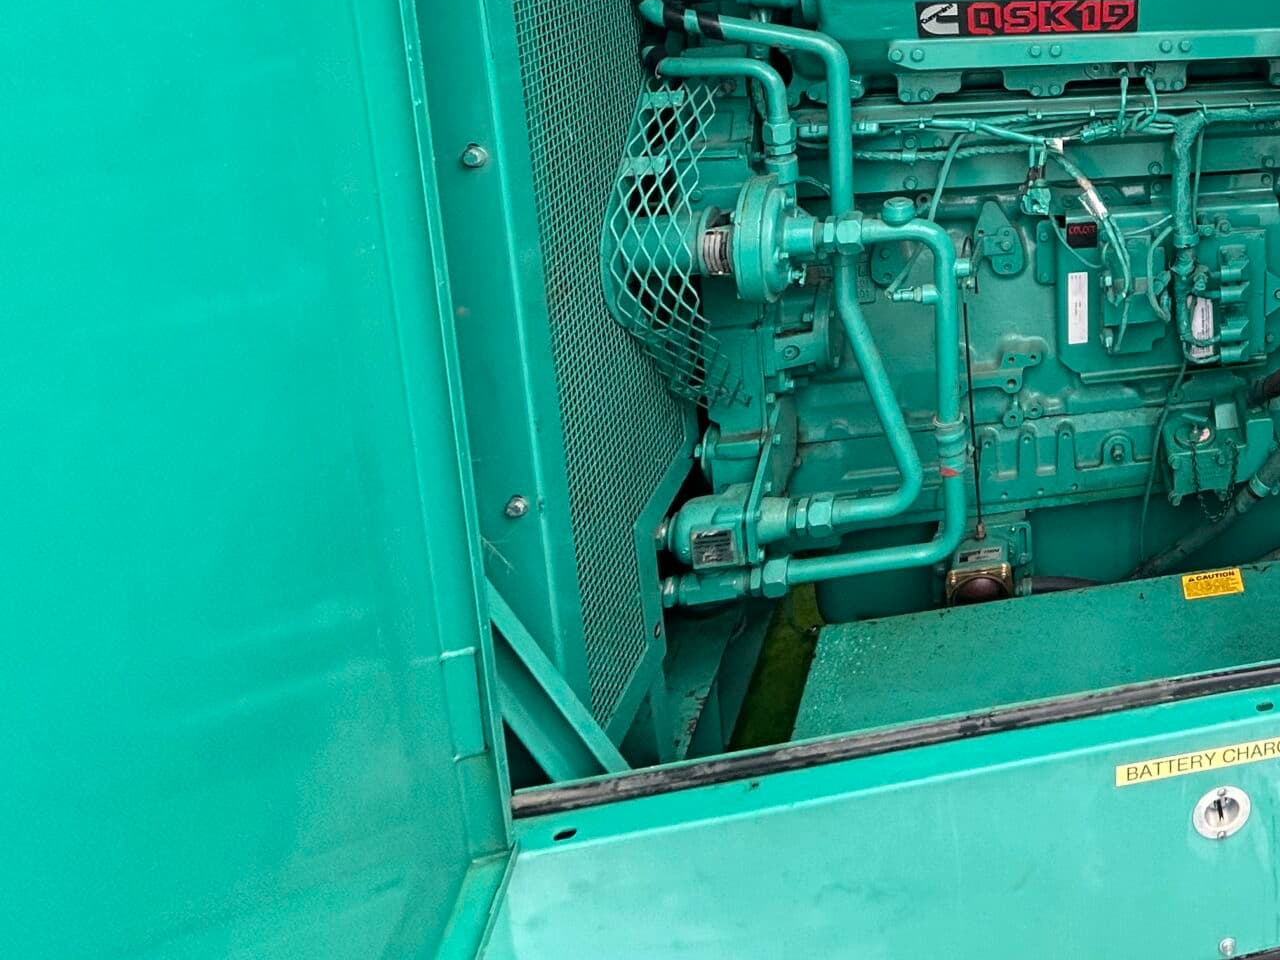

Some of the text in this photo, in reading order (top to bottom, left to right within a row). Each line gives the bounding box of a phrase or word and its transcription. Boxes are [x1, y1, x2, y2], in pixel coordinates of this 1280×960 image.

[966, 0, 1135, 36] QSK19
[1195, 570, 1235, 581] CAUTION
[1126, 752, 1217, 782] BATTERY
